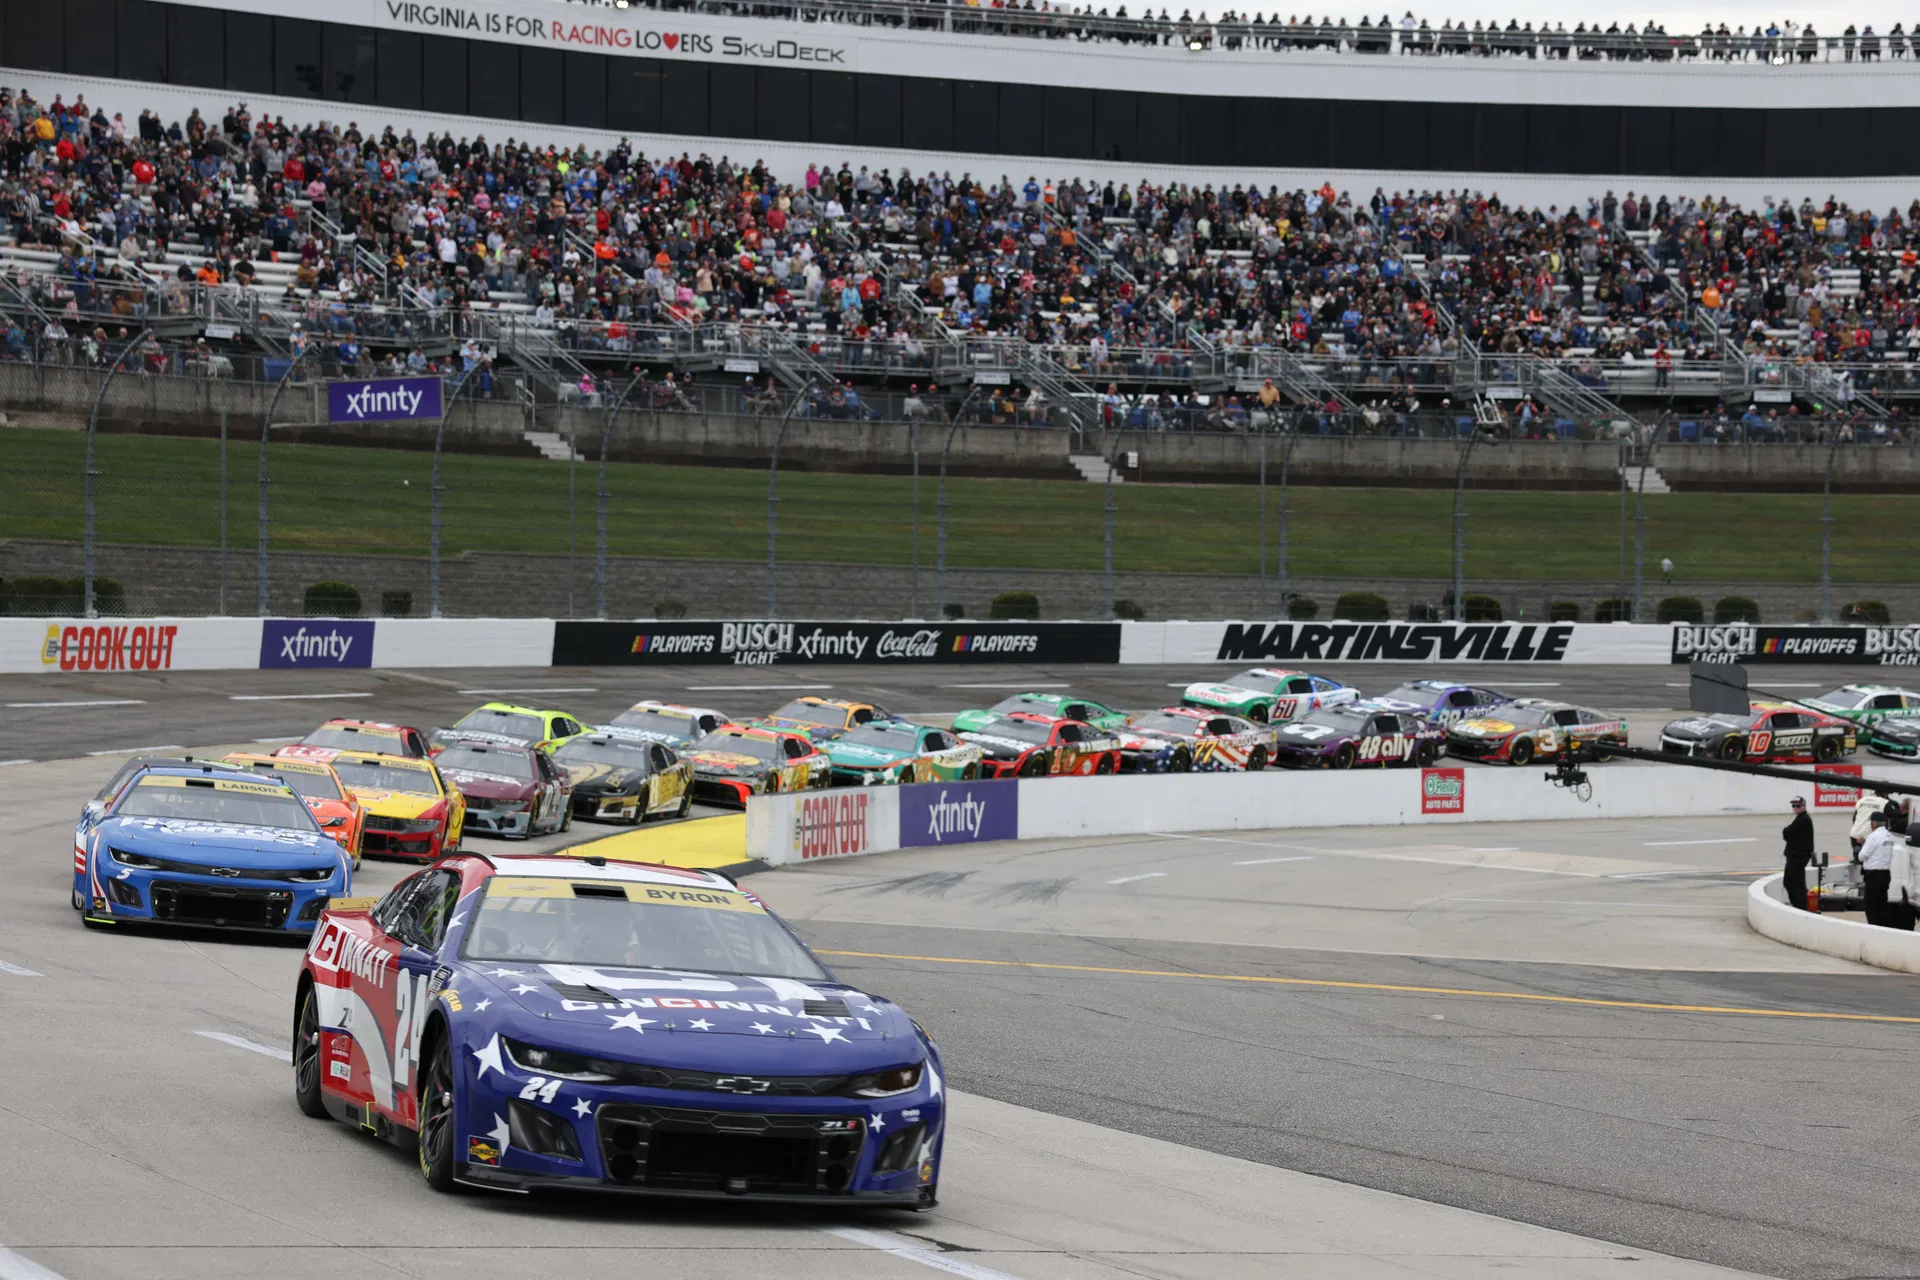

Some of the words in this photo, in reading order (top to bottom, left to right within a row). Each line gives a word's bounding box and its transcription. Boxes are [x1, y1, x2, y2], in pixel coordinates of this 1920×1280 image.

[387, 0, 480, 31] VIRGINIA
[486, 13, 501, 33] IS
[506, 16, 547, 39] FOR
[552, 21, 632, 48] RACING
[346, 384, 423, 418] xfinity
[61, 626, 127, 670] COOK
[130, 625, 177, 669] OUT
[280, 627, 353, 662] xfinity
[650, 635, 715, 653] PLAYOFFS
[720, 623, 795, 653] BUSCH
[797, 628, 869, 659] xfinity
[971, 635, 1038, 652] PLAYOFFS
[1217, 624, 1574, 661] MARTINSVILLE
[1676, 627, 1757, 655] BUSCH
[1783, 639, 1858, 655] PLAYOFFS
[731, 651, 780, 665] LIGHT
[1272, 698, 1298, 719] 60
[1194, 740, 1219, 764] 77
[1358, 735, 1382, 760] 48
[1381, 733, 1415, 762] ally
[1538, 728, 1558, 752] 3
[1746, 731, 1772, 755] 10
[283, 764, 325, 775] HAMLIN
[222, 783, 278, 794] LARSON
[1820, 794, 1836, 802] AUTO
[1837, 794, 1858, 803] PARTS
[802, 794, 840, 859] COOK
[840, 793, 868, 853] OUT
[928, 791, 985, 841] xfinity
[116, 868, 134, 880] 5
[646, 889, 732, 905] BYRON
[394, 967, 428, 1086] 24
[518, 1076, 564, 1104] 24
